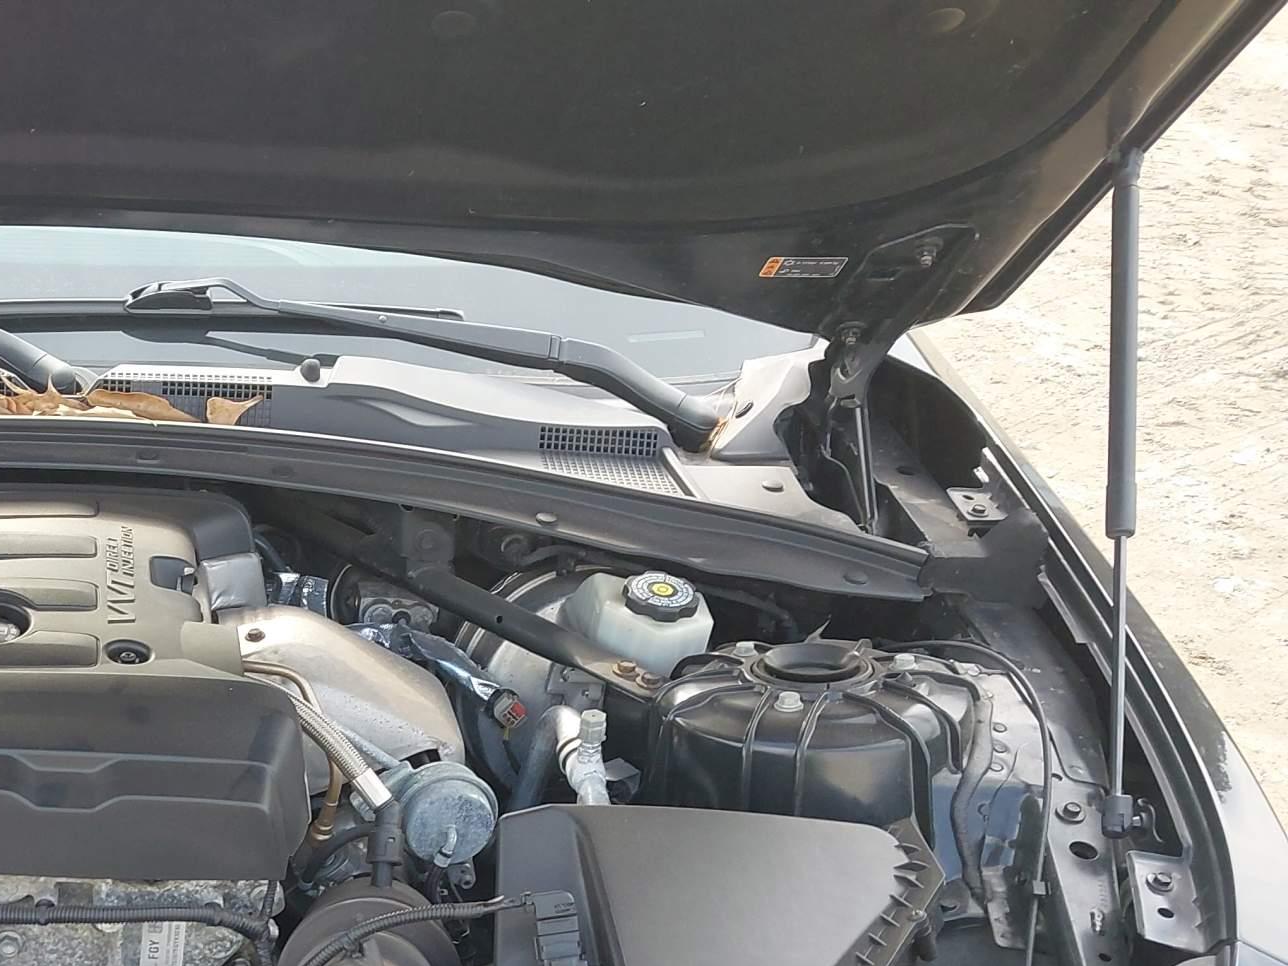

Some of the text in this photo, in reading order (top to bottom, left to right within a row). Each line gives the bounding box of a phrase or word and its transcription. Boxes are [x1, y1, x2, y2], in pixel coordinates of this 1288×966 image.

[120, 525, 135, 577] INJECTION
[106, 569, 136, 625] VVT
[147, 939, 160, 960] FGY
